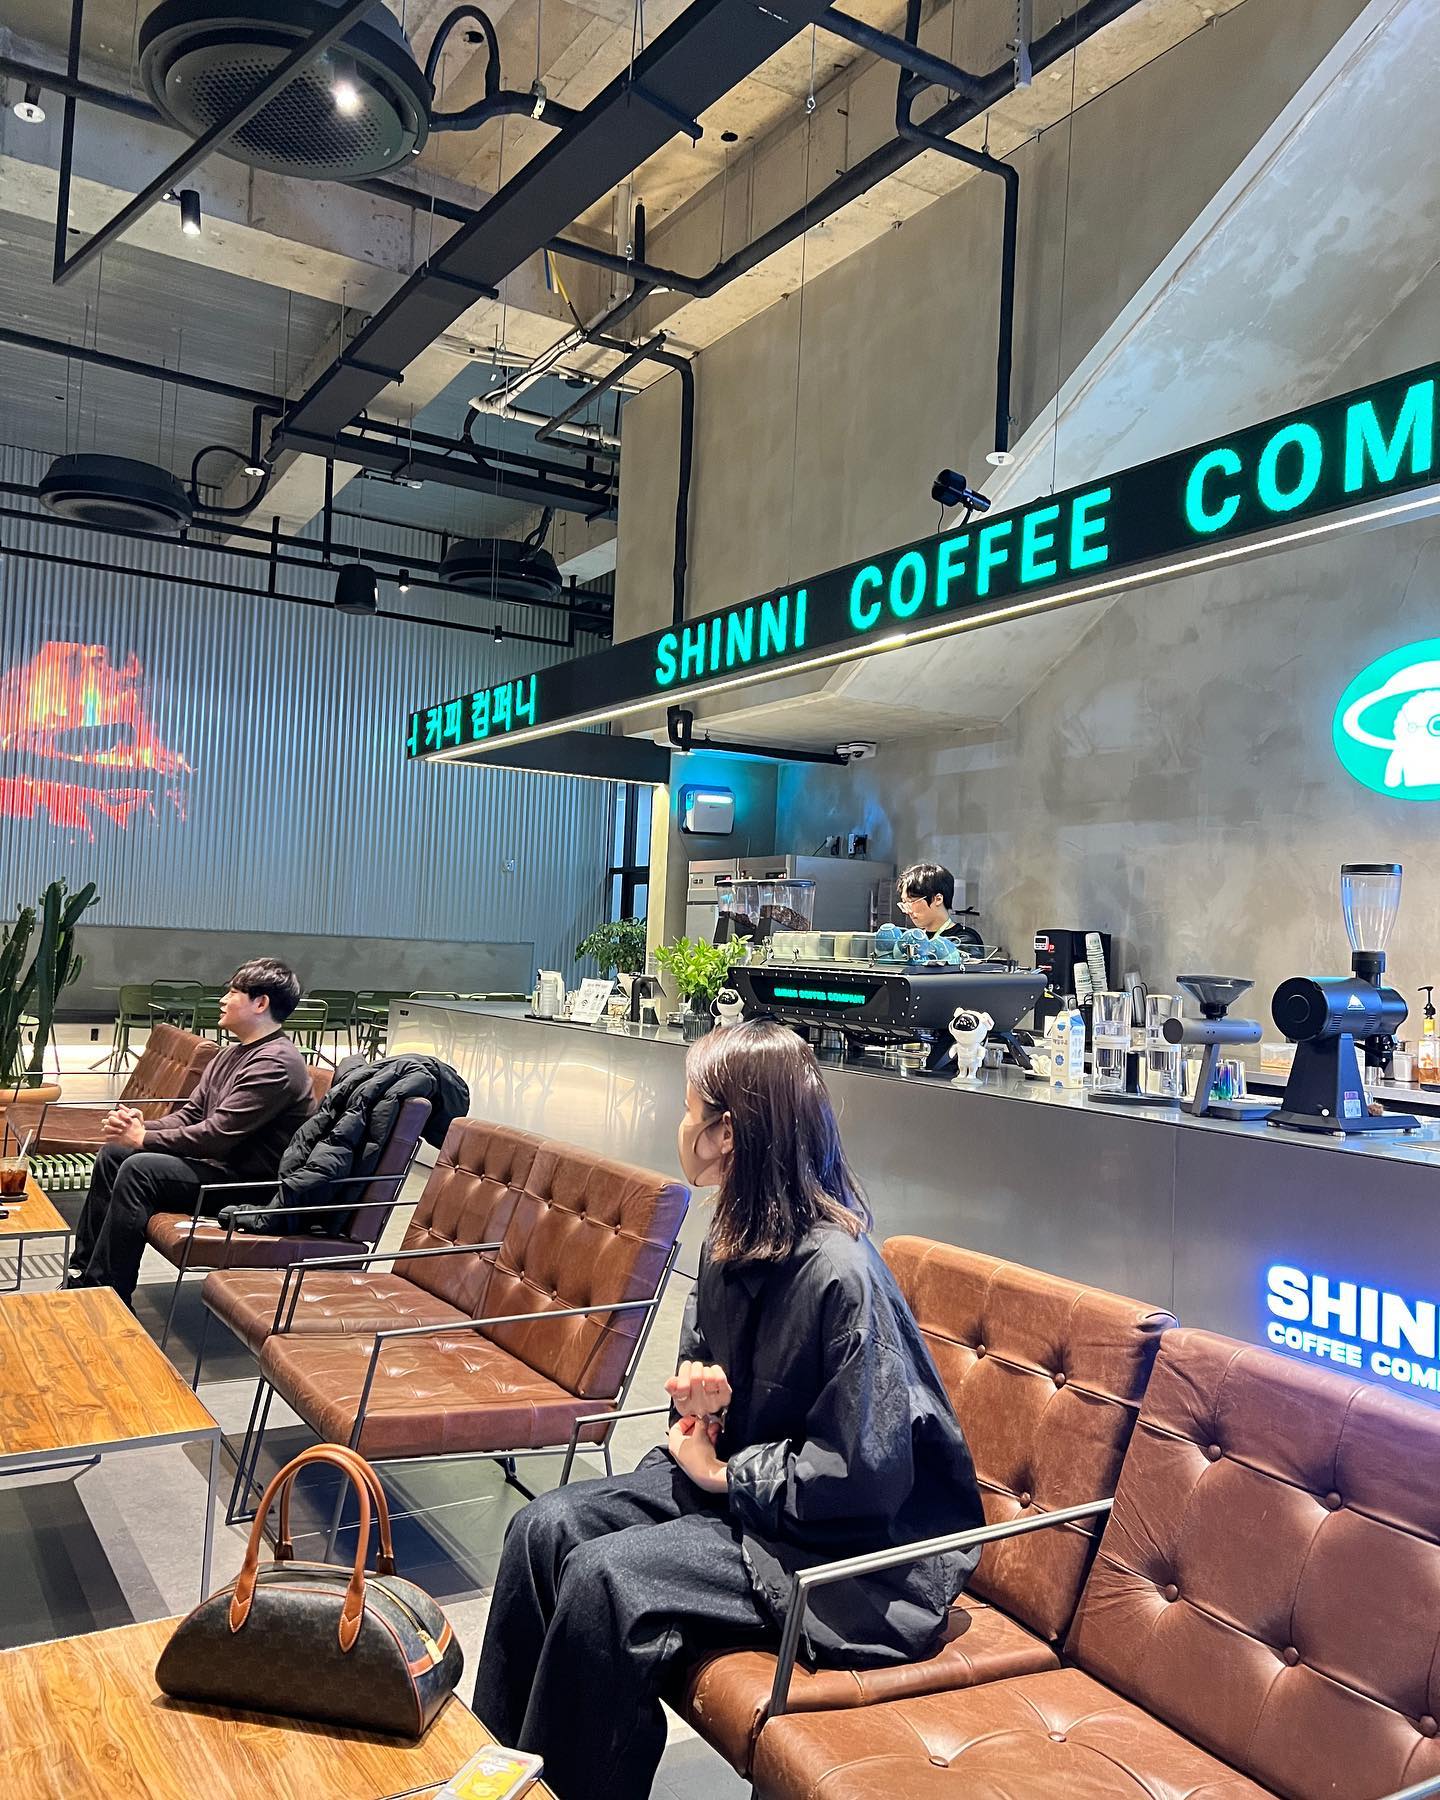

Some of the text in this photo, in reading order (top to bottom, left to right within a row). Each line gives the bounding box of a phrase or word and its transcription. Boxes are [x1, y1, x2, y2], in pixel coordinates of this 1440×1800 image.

[655, 379, 1435, 685] SHINNI COFFEE COM
[425, 699, 463, 750] 커피
[471, 673, 537, 740] 컴퍼니
[1267, 1265, 1440, 1360] SHIN
[1267, 1321, 1440, 1393] COFFEE COM
